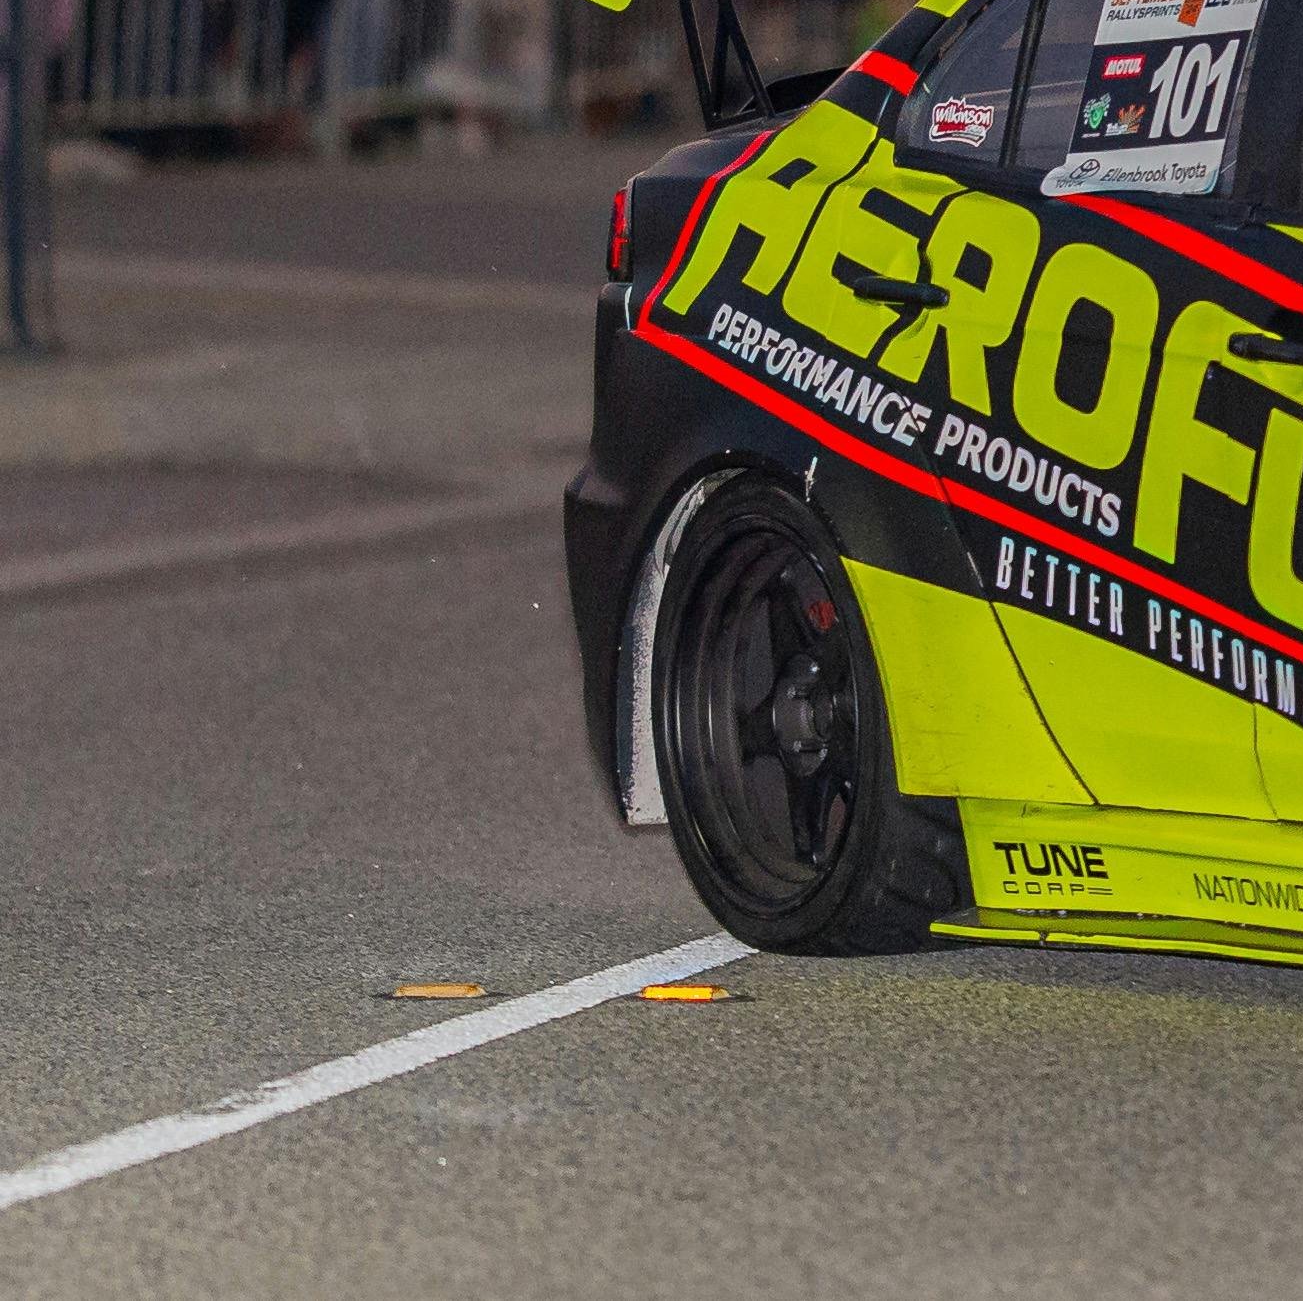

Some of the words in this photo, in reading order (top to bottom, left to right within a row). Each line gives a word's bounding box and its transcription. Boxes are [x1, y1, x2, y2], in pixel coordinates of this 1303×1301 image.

[1106, 4, 1181, 21] RALLYSPRINTS
[1107, 58, 1142, 75] MOTUL
[1148, 39, 1240, 139] 101
[1101, 166, 1167, 183] Ellenbrook
[1171, 163, 1207, 182] Toyota
[707, 303, 932, 447] PERFORMANCE
[934, 413, 1122, 537] PRODUCTS
[995, 536, 1125, 637] BETTER
[992, 841, 1110, 880] TUNE
[1002, 880, 1086, 896] CORP
